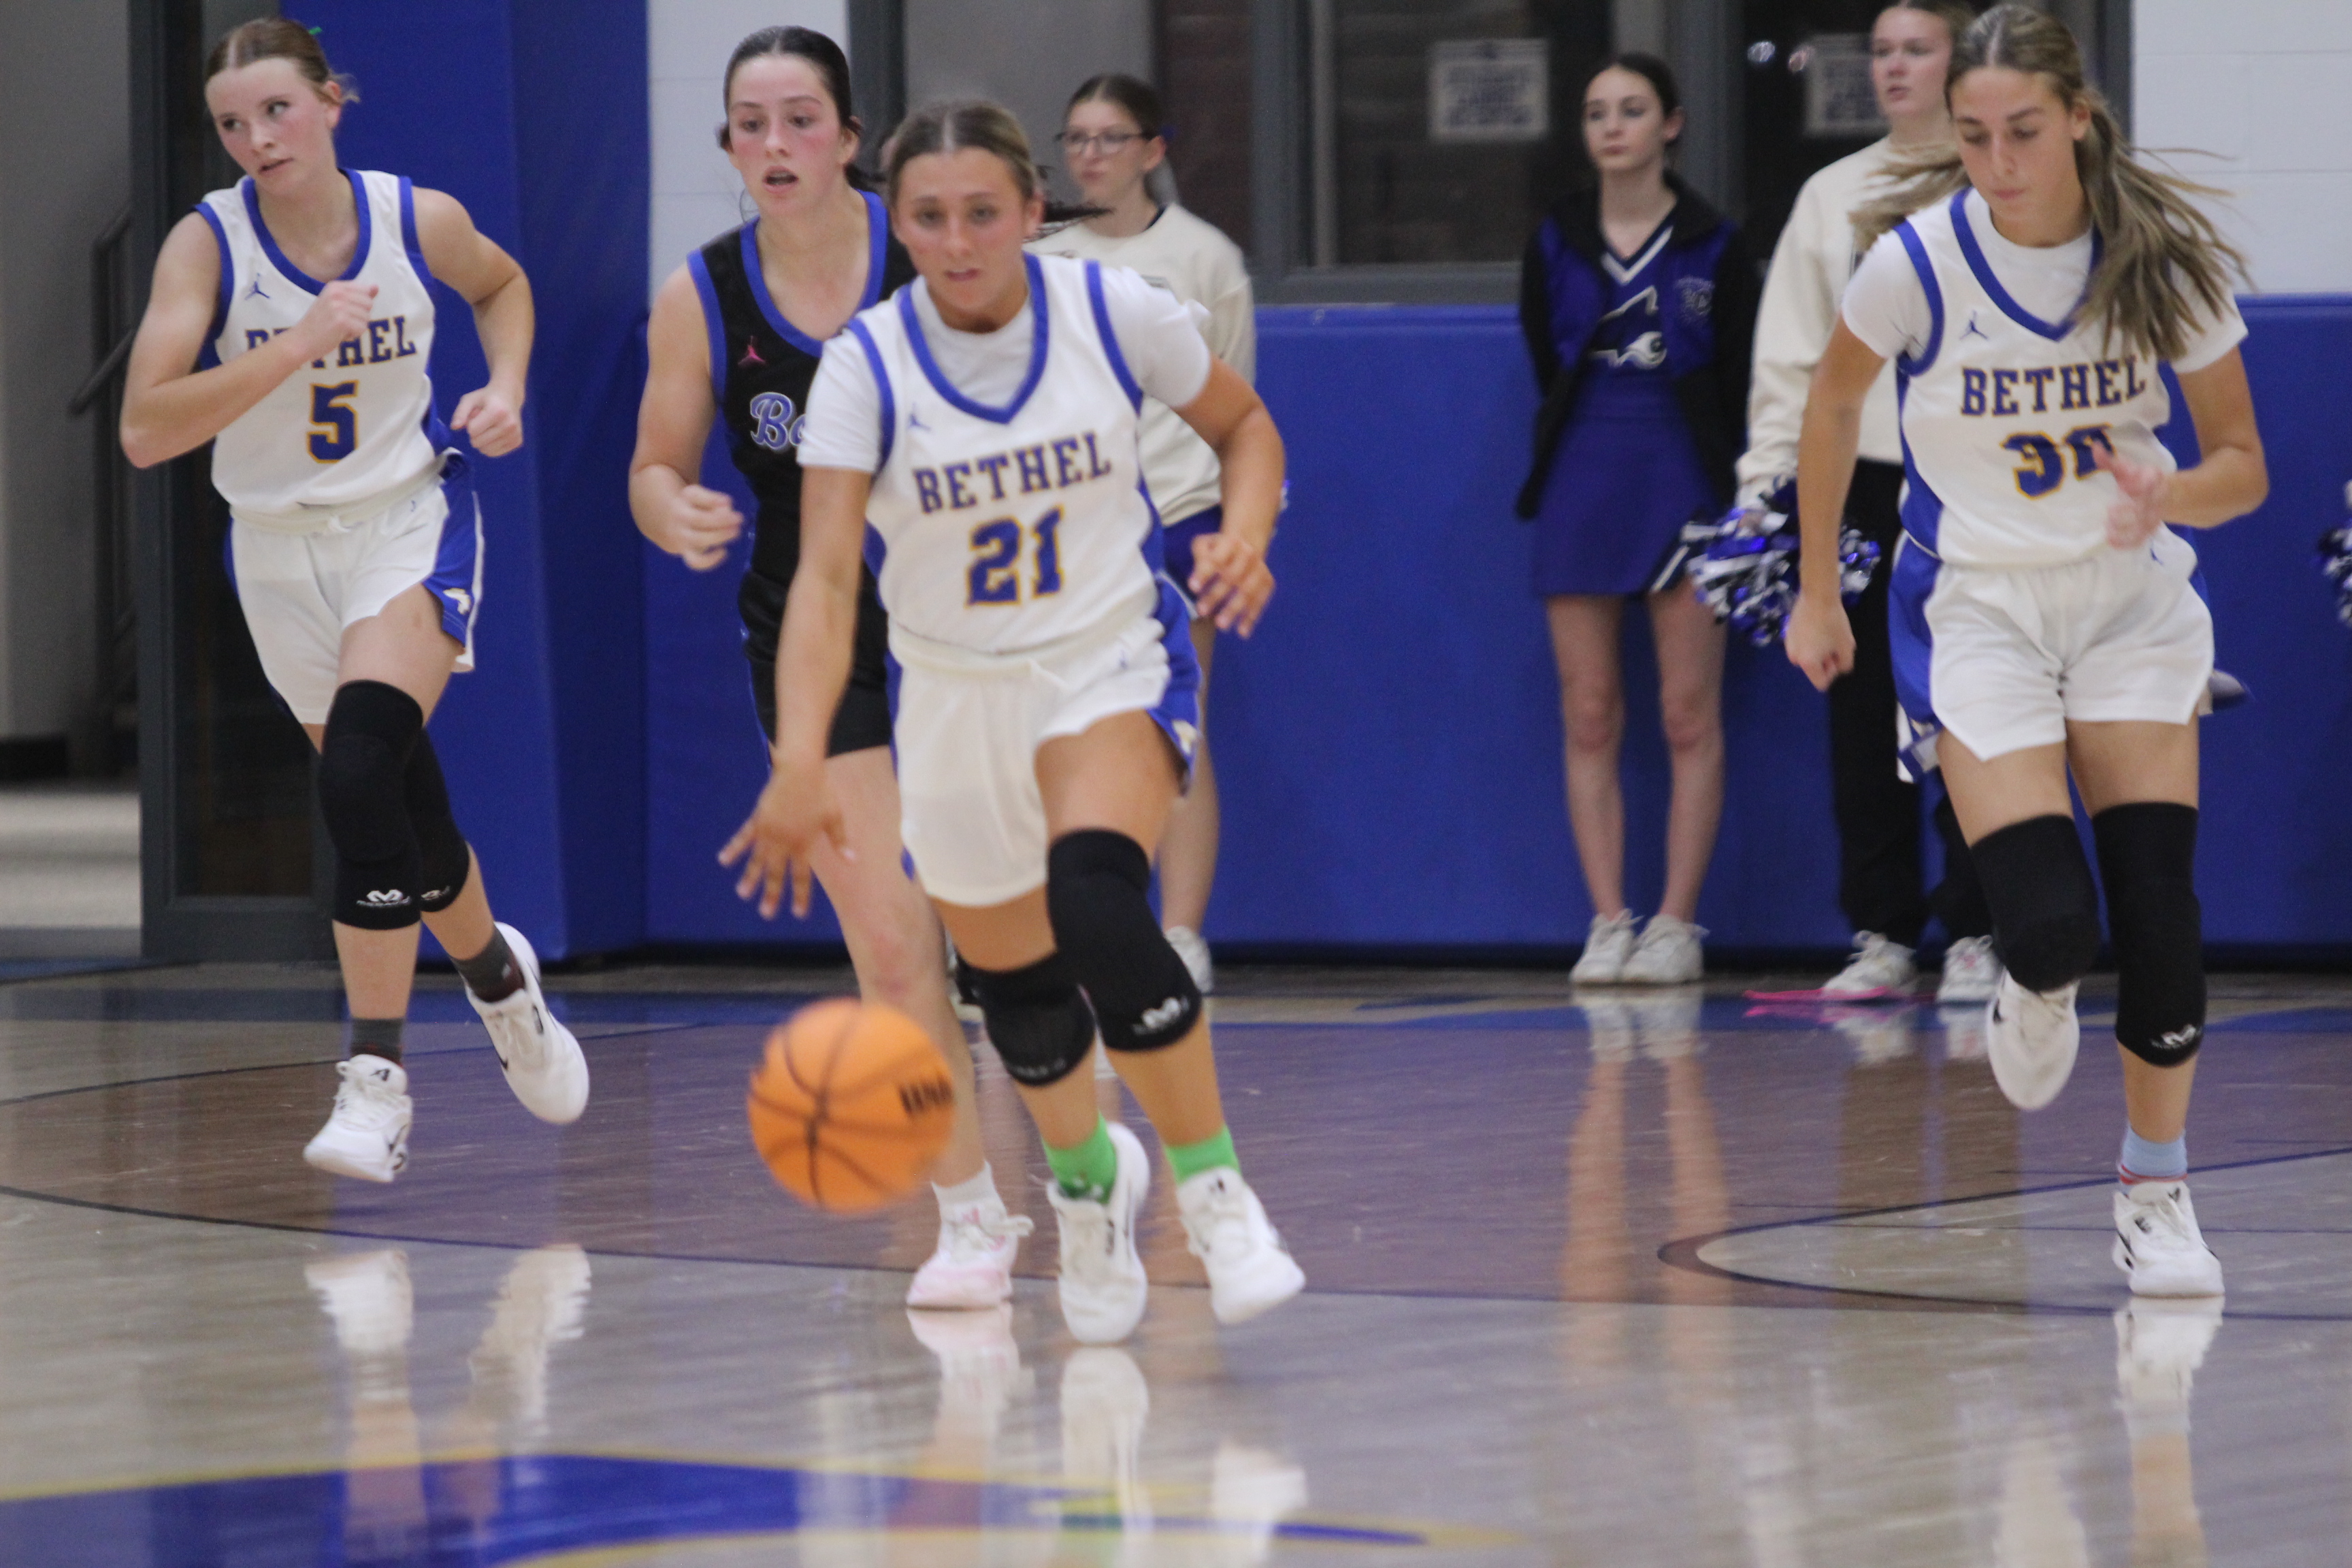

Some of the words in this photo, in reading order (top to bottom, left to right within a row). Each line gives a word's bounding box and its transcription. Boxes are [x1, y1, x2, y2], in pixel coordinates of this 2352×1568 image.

[306, 379, 360, 464] 5
[1959, 355, 2146, 416] BETHEL
[911, 430, 1112, 514] BETHEL
[965, 503, 1064, 608] 21
